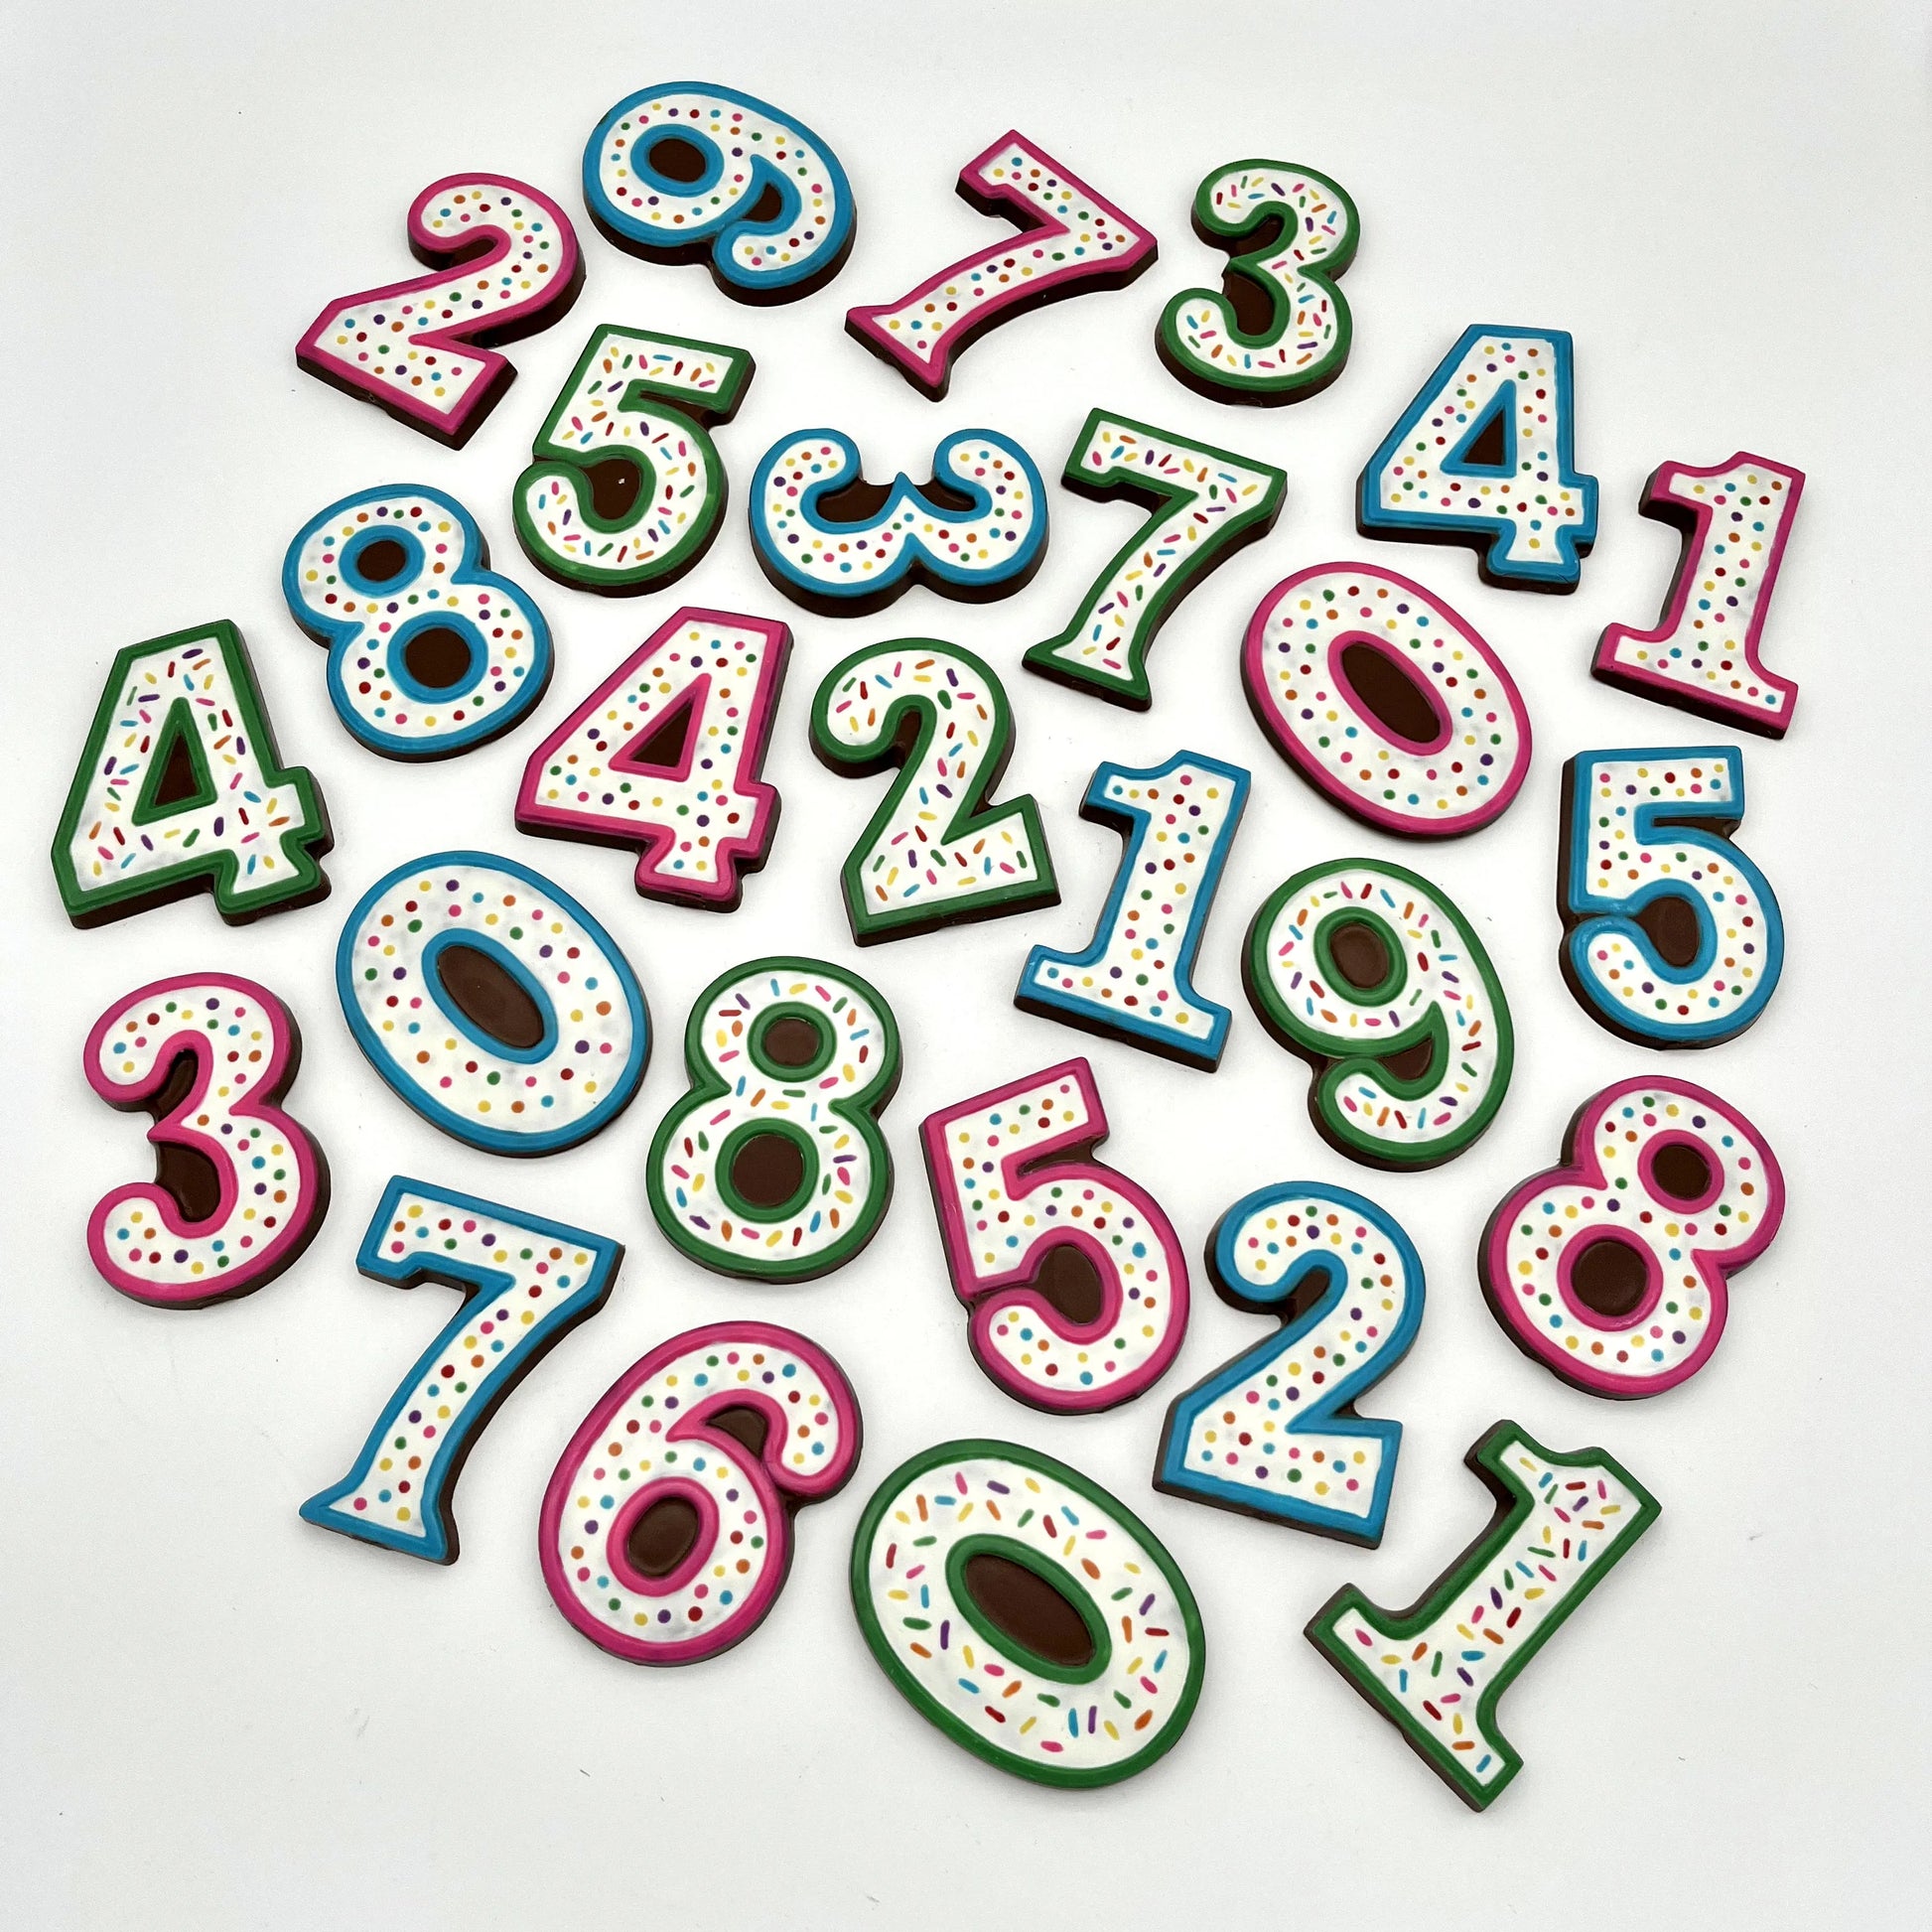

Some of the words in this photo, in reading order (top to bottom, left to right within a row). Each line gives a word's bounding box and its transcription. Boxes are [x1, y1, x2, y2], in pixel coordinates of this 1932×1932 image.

[297, 175, 576, 431] 2
[849, 131, 1155, 383] 7
[1160, 160, 1359, 395] 3
[514, 326, 748, 583] 5
[1028, 410, 1285, 697] 7
[1363, 326, 1597, 580] 4
[1600, 453, 1803, 727] 1
[283, 485, 549, 752] 8
[517, 608, 786, 897] 4
[54, 622, 322, 913] 4
[812, 639, 1053, 931] 2
[1020, 752, 1250, 1057] 1
[1565, 747, 1784, 1042] 5
[84, 974, 316, 1300] 3
[648, 956, 900, 1277] 8
[1252, 860, 1512, 1160] 9
[301, 1176, 617, 1559] 7
[925, 1058, 1188, 1408] 5
[1164, 1182, 1424, 1537] 2
[1489, 1076, 1784, 1394] 8
[540, 1322, 855, 1660] 6
[1311, 1422, 1661, 1809] 1
